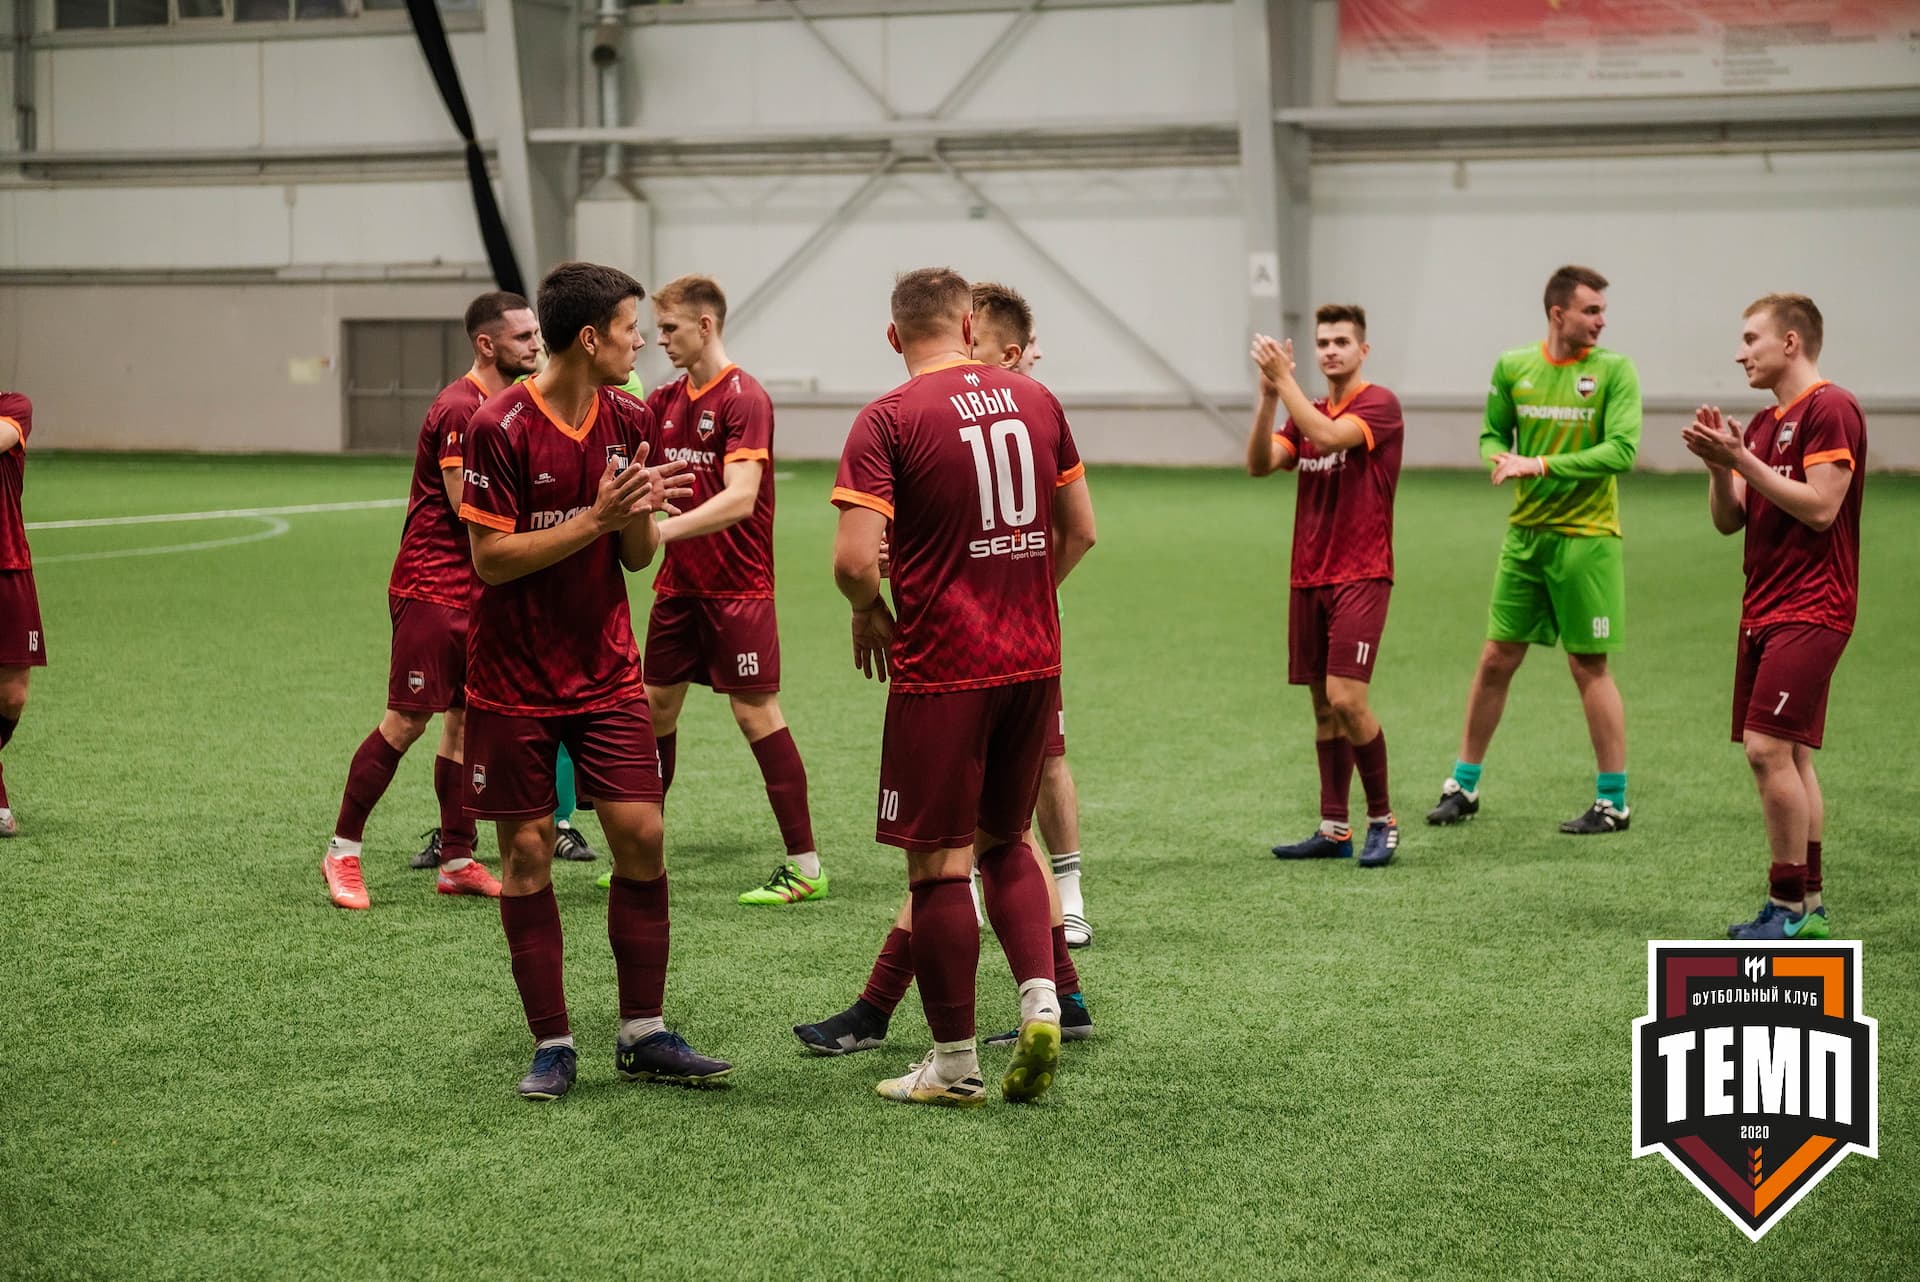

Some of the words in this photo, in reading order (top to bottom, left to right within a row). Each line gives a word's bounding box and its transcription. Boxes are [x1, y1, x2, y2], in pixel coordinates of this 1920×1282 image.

[950, 388, 1019, 422] ЦВЫК
[464, 469, 489, 488] ПСБ
[959, 419, 1037, 531] 10
[1011, 552, 1029, 560] Export
[1029, 550, 1046, 558] Union
[1593, 617, 1609, 638] 99
[28, 630, 38, 652] 15
[1356, 641, 1369, 665] 11
[737, 652, 759, 676] 25
[1773, 691, 1789, 715] 7
[880, 788, 899, 821] 10
